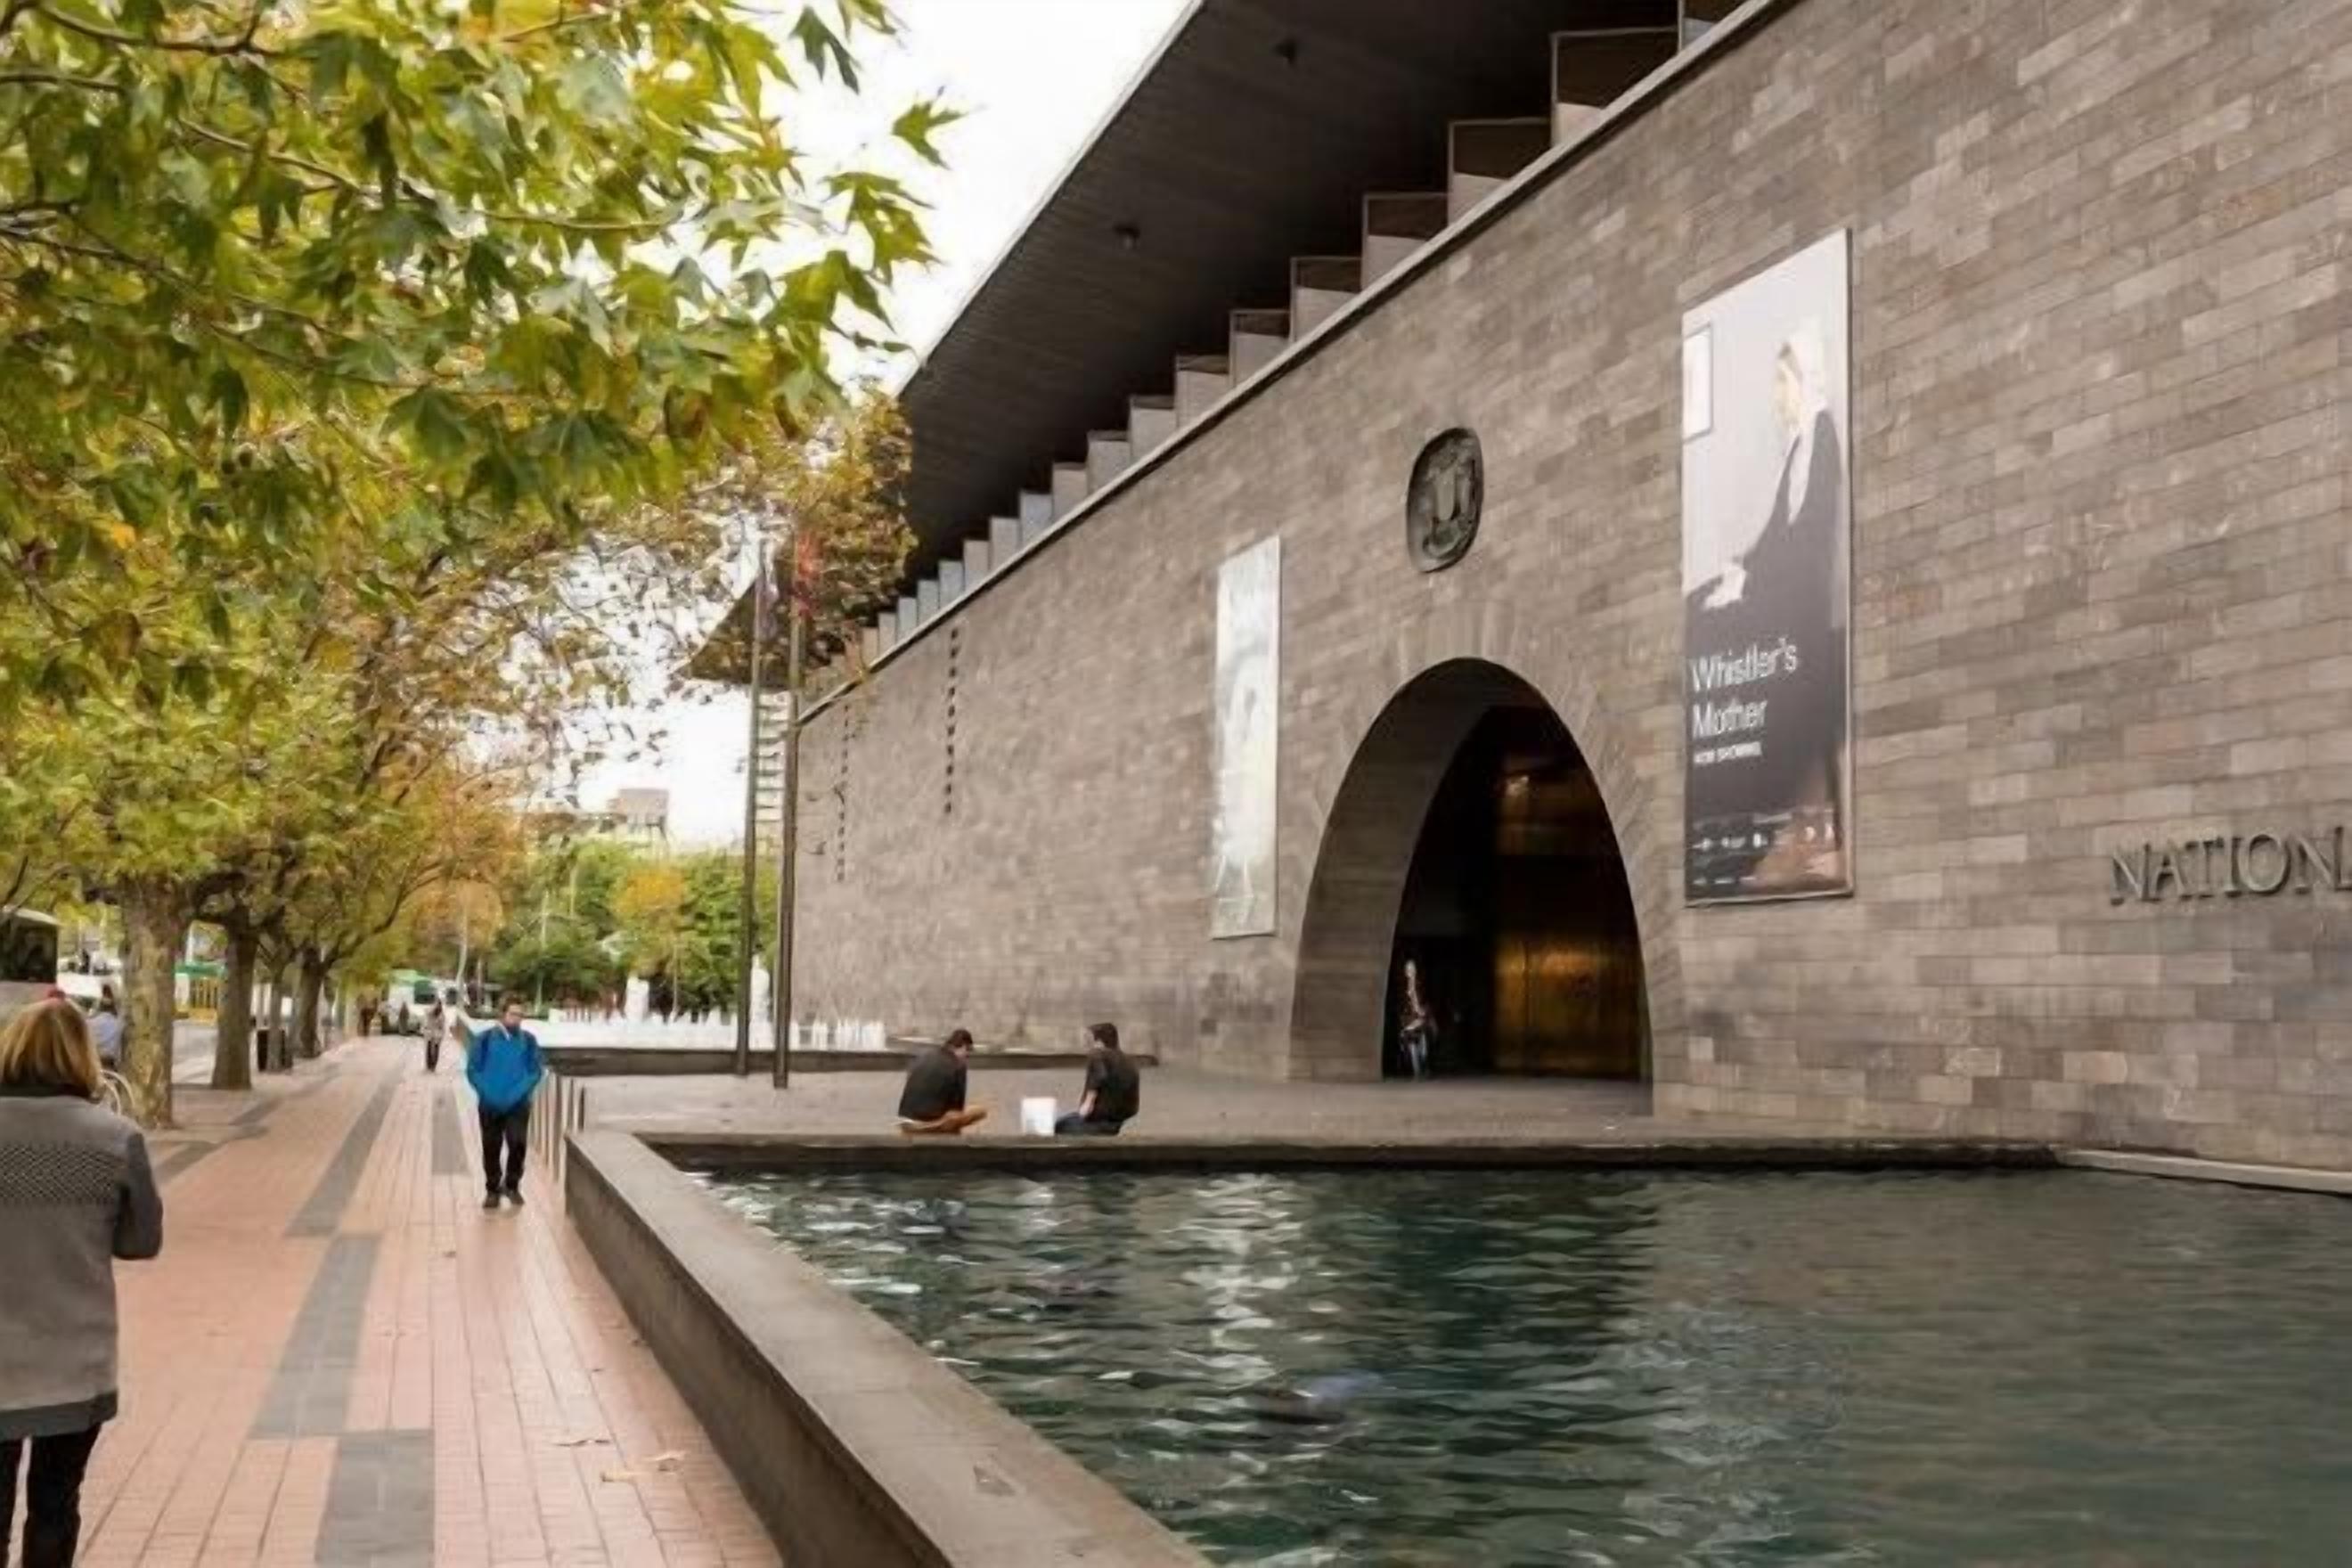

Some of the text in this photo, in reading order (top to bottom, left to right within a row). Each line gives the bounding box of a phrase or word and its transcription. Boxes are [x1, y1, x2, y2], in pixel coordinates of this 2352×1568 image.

[1691, 638, 1798, 692] Whistler's
[1693, 699, 1768, 738] Mother
[2110, 826, 2352, 905] NATION
